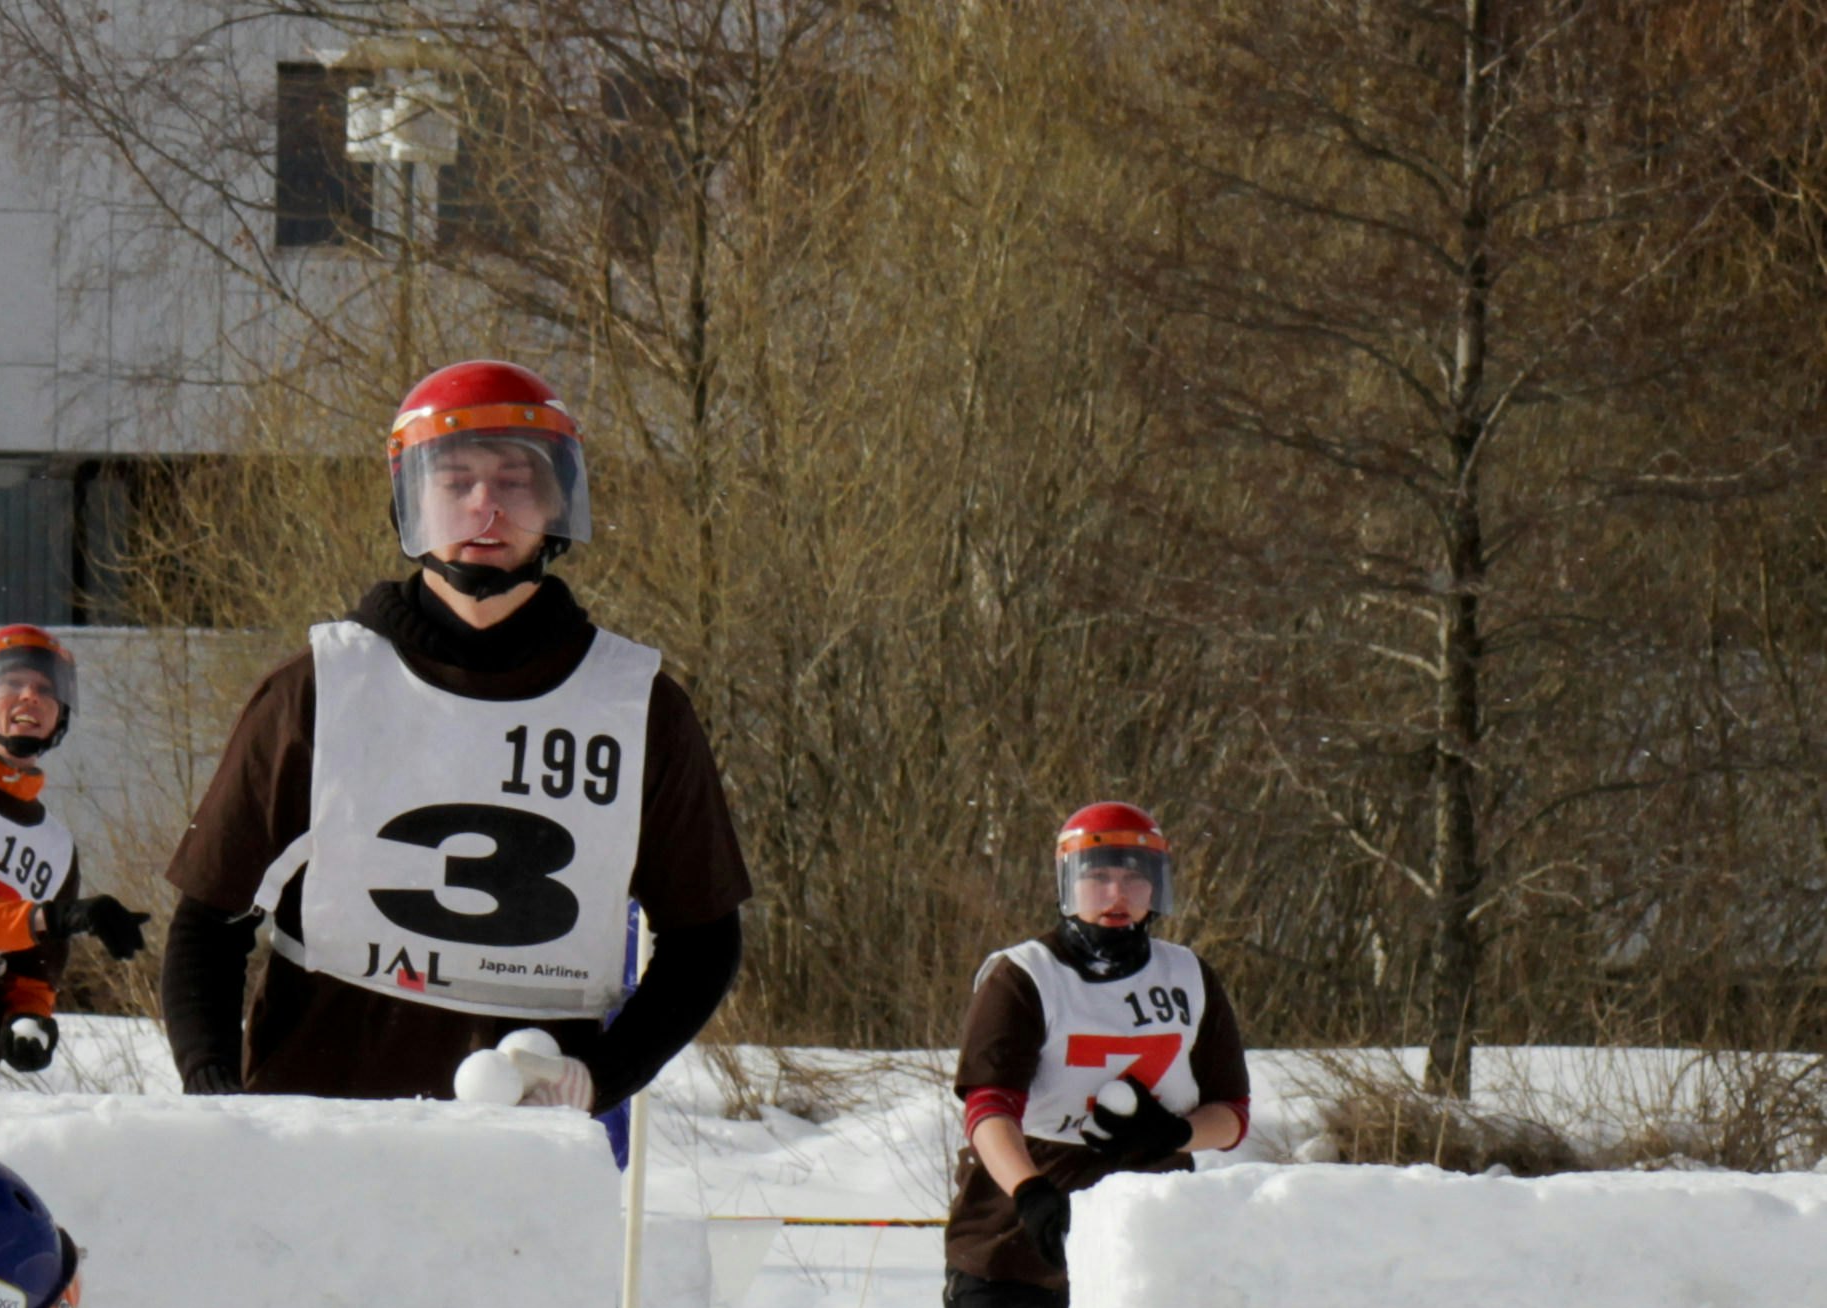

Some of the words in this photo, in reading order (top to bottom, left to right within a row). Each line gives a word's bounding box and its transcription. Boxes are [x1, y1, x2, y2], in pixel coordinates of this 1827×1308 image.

[501, 724, 622, 806] 199
[368, 802, 580, 948] 3
[362, 942, 453, 988] JAL
[479, 957, 528, 976] Japan
[533, 963, 590, 980] Airlines
[1125, 986, 1191, 1028] 199
[1066, 1032, 1183, 1112] 7
